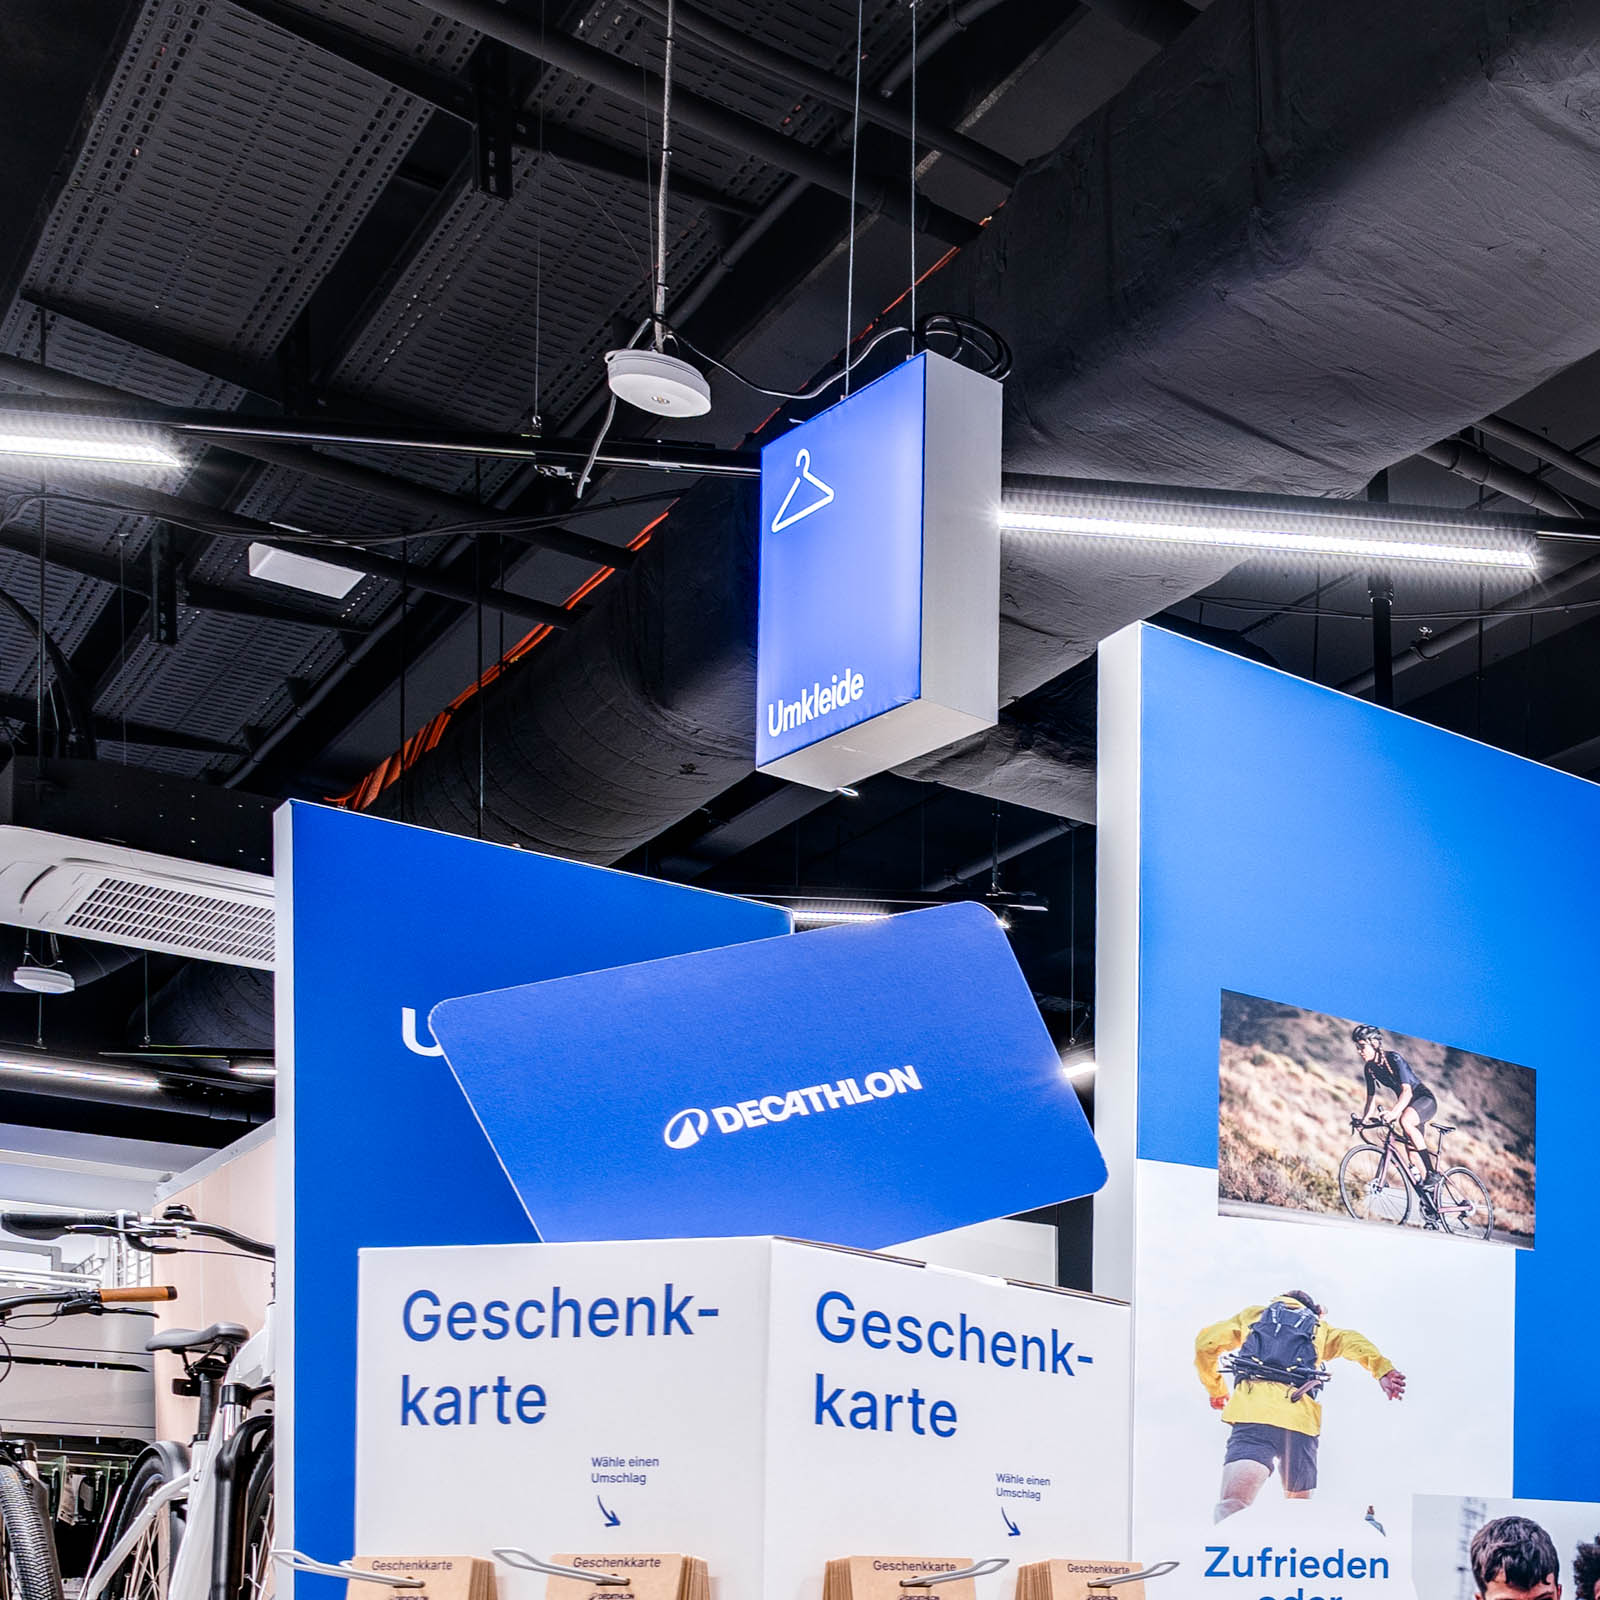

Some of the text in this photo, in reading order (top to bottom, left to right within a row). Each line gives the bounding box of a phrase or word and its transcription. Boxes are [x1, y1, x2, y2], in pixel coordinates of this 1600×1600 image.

[768, 672, 864, 736] Umkleide
[711, 1066, 922, 1133] DECATHLON
[403, 1284, 718, 1342] Geschenk-
[816, 1291, 1092, 1376] Geschenk-
[401, 1375, 546, 1426] karte
[816, 1374, 957, 1437] karte
[591, 1455, 660, 1468] Wähle einen
[591, 1472, 647, 1486] Umschlag
[995, 1472, 1051, 1487] Wähle einen
[995, 1487, 1041, 1503] Umschlag
[371, 1559, 453, 1571] Geschenkkarte
[572, 1556, 662, 1569] Geschenkkarte
[872, 1559, 957, 1573] Geschenkkarte
[1204, 1546, 1388, 1578] Zufrieden
